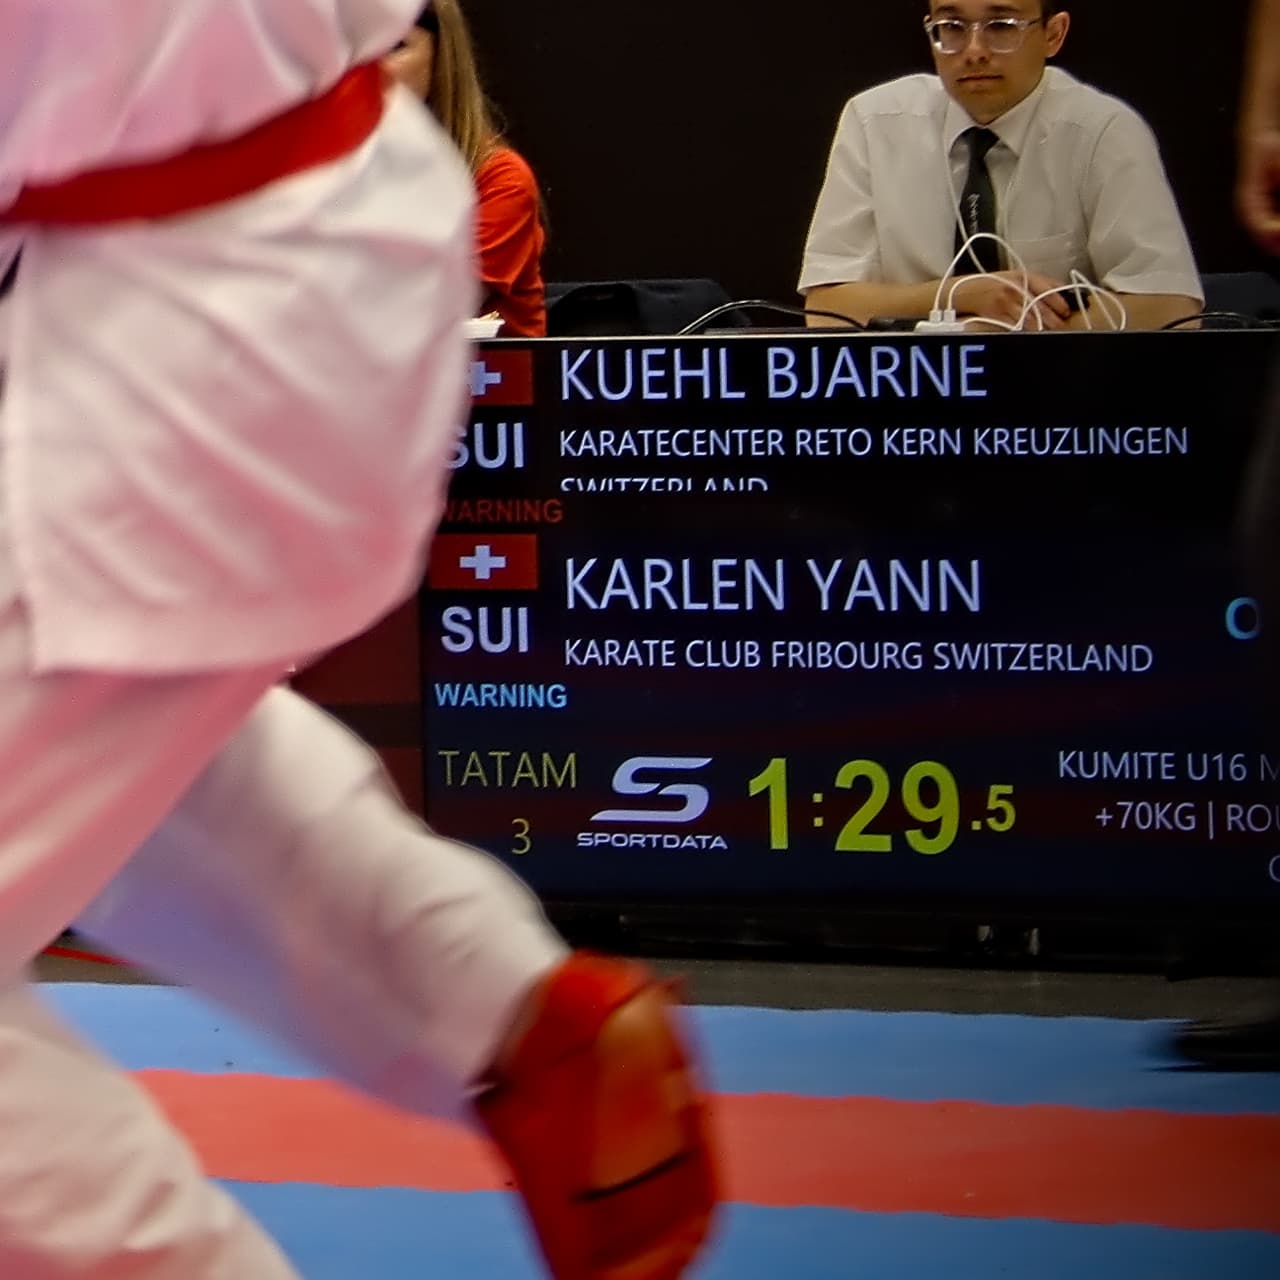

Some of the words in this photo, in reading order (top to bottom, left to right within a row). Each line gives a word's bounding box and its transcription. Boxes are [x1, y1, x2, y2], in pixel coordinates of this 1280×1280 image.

[561, 347, 746, 401] KUEHL
[766, 344, 988, 399] BJARNE
[559, 429, 786, 457] KARATECENTER
[795, 427, 872, 457] RETO
[883, 427, 962, 456] KERN
[973, 426, 1188, 455] KREUZLINGEN
[566, 557, 785, 611] KARLEN
[806, 558, 980, 612] YANN
[441, 606, 529, 653] SUI
[564, 638, 677, 667] KARATE
[685, 639, 761, 668] CLUB
[772, 640, 923, 669] FRIBOURG
[933, 642, 1153, 672] SWITZERLAND
[435, 682, 568, 708] WARNING
[438, 750, 577, 789] TATAM
[1058, 750, 1177, 780] KUMITE
[1187, 752, 1248, 782] U16
[1095, 801, 1196, 831] +70KG
[1227, 803, 1280, 832] RO
[511, 817, 531, 855] 3
[576, 831, 728, 851] SPORTDATA
